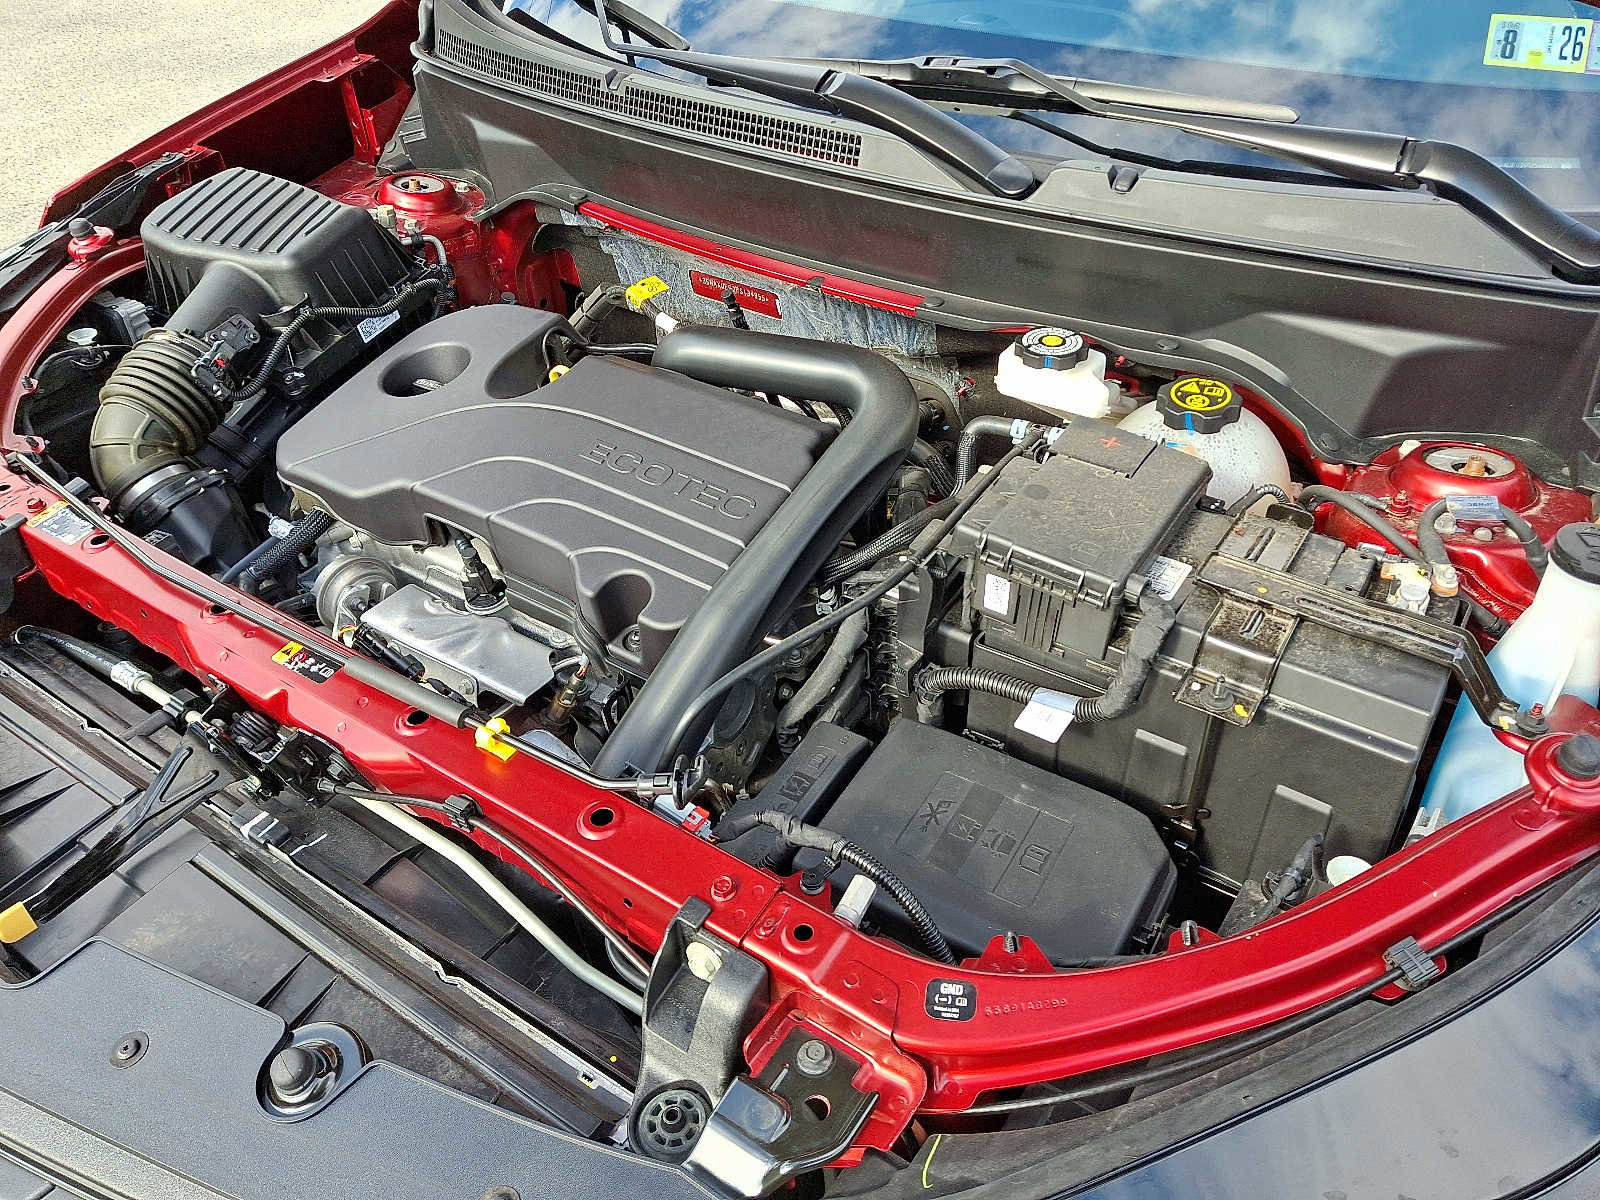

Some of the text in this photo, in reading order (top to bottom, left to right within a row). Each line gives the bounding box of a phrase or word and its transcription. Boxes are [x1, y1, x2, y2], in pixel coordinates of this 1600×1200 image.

[1500, 29, 1518, 59] 8
[1558, 25, 1586, 61] 26
[579, 439, 757, 520] ECOTEC
[940, 982, 964, 996] GND
